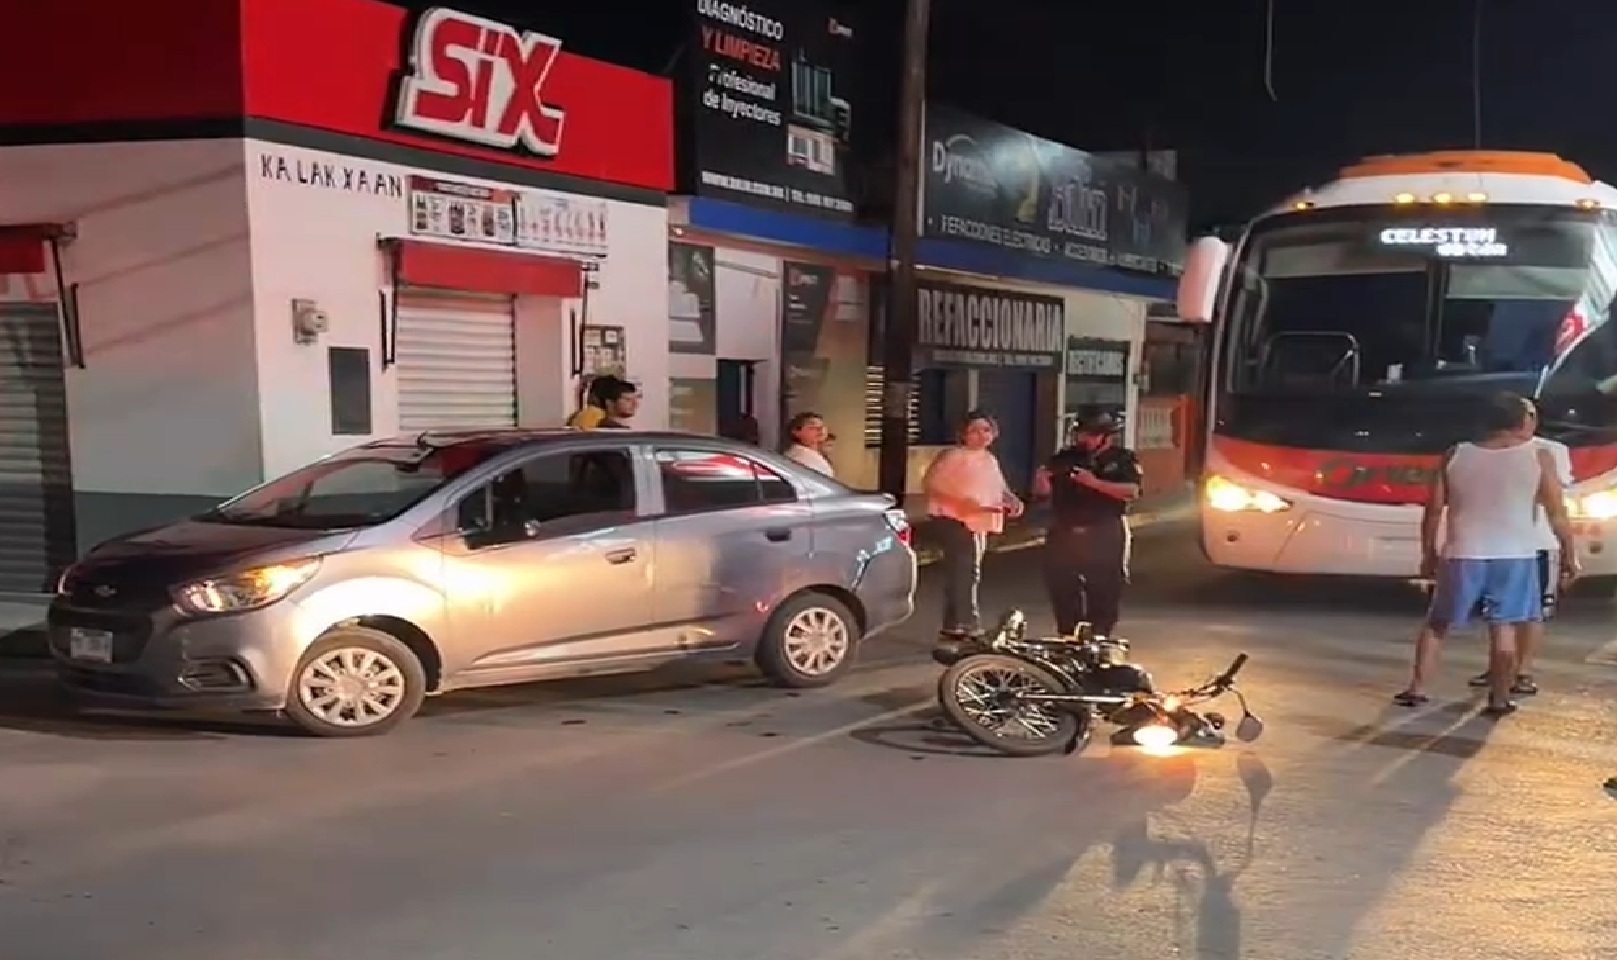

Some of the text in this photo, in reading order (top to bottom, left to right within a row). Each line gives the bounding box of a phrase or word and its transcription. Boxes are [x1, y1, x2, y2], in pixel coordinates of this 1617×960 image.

[715, 29, 781, 71] LIMPIEZA
[703, 88, 720, 109] de
[917, 288, 1064, 351] REFACCIONARIA
